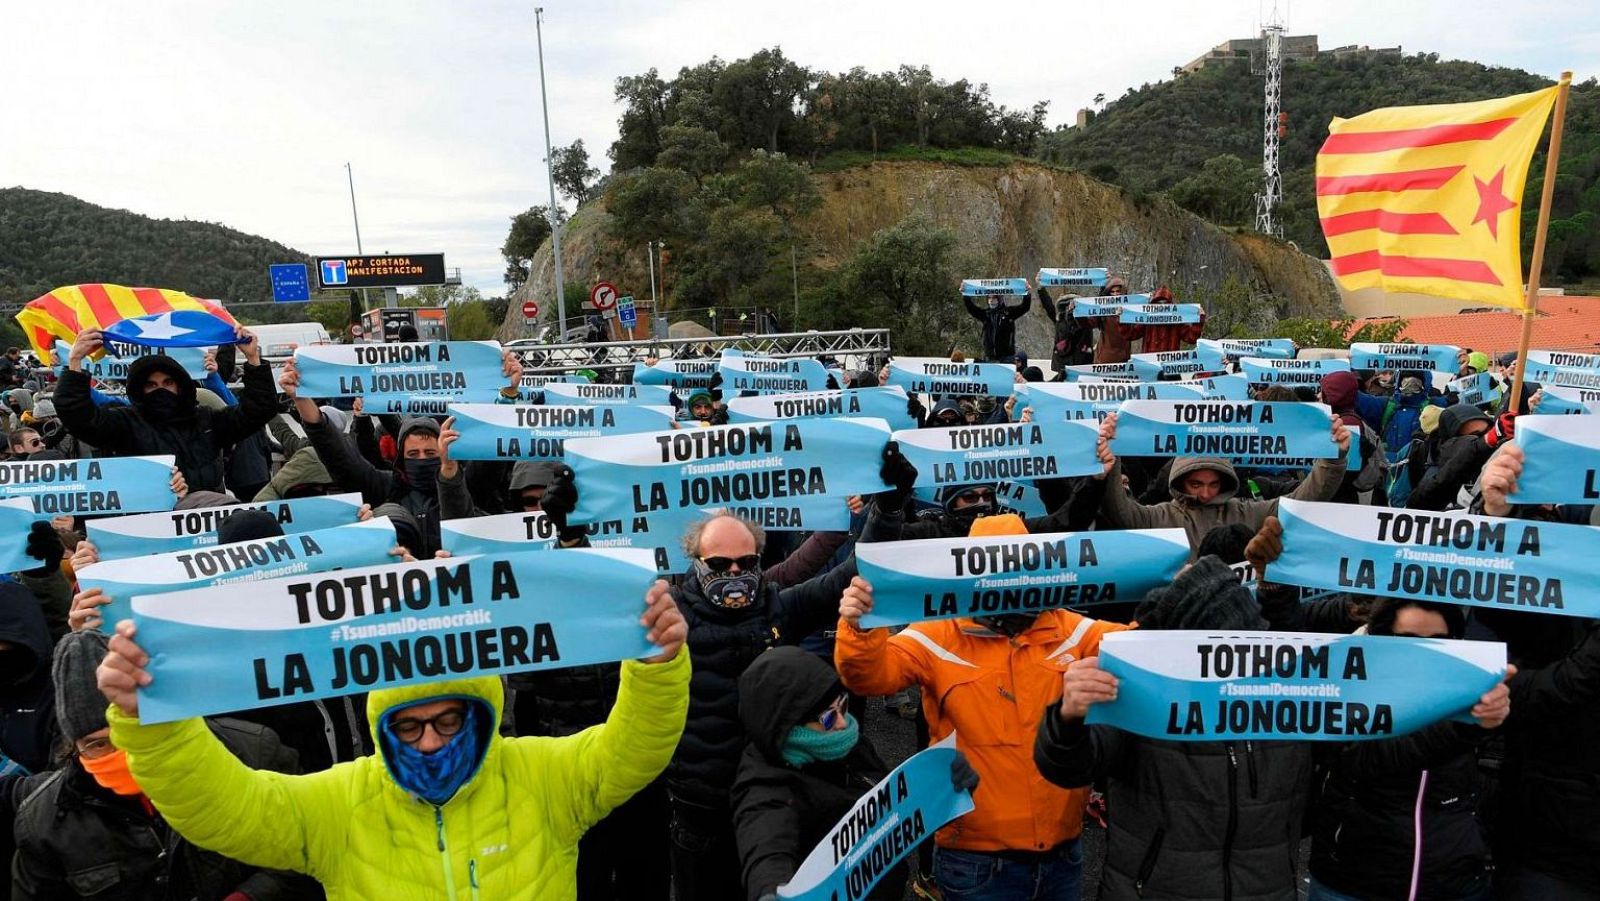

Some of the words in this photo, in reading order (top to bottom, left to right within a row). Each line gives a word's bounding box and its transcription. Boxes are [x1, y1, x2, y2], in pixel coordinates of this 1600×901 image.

[346, 259, 364, 267] AP7
[370, 258, 410, 266] CORTADA
[347, 266, 423, 276] MANIFESTACION
[1142, 305, 1170, 313] TOTHOM
[1145, 315, 1182, 323] JONQUERA
[355, 345, 430, 365] TOTHOM
[438, 344, 450, 362] A
[1156, 353, 1190, 362] TOTHOM
[1192, 351, 1198, 360] A
[1378, 344, 1418, 354] TOTHOM
[1422, 345, 1429, 354] A
[674, 362, 715, 373] TOTHOM
[744, 360, 788, 372] TOTHOM
[792, 362, 800, 372] A
[923, 363, 968, 376] TOTHOM
[972, 364, 980, 376] A
[1092, 365, 1126, 373] TOTHOM
[1128, 364, 1134, 372] A
[1270, 360, 1310, 368] TOTHOM
[1314, 360, 1322, 368] A
[1367, 359, 1380, 369] LA
[1383, 360, 1436, 370] JONQUERA
[1550, 353, 1591, 368] TOTHOM
[339, 376, 364, 394] LA
[370, 372, 467, 393] JONQUERA
[734, 378, 748, 389] LA
[751, 378, 808, 391] JONQUERA
[912, 382, 926, 392] LA
[930, 382, 988, 394] JONQUERA
[1208, 379, 1216, 390] A
[1260, 373, 1272, 382] LA
[1276, 374, 1325, 383] JONQUER
[1534, 370, 1549, 381] LA
[1551, 372, 1600, 387] JONQUER
[576, 385, 624, 399] TOTHOM
[629, 386, 637, 398] A
[1078, 385, 1140, 402] TOTHOM
[1147, 386, 1157, 400] A
[387, 400, 402, 413] LA
[406, 400, 447, 413] JONQU
[774, 396, 842, 418] TOTHOM
[849, 396, 861, 413] A
[1174, 404, 1252, 424] TOTHOM
[1260, 405, 1274, 424] A
[516, 408, 594, 427] TOTHOM
[602, 408, 616, 427] A
[496, 438, 522, 457] LA
[656, 424, 772, 463] TOTHOM
[783, 424, 803, 452] A
[949, 426, 1023, 450] TOTHOM
[1030, 425, 1043, 444] A
[1154, 434, 1178, 454] LA
[1184, 434, 1288, 454] JONQUERA
[0, 462, 78, 485] OTHOM
[86, 461, 102, 480] A
[680, 456, 782, 476] #TsunamiDemocràtic
[934, 463, 958, 484] LA
[964, 456, 1058, 482] JONQUERA
[632, 482, 670, 514] LA
[678, 466, 826, 508] JONQUERA
[1584, 470, 1600, 498] L
[32, 490, 122, 514] NQUERA
[278, 503, 292, 524] A
[731, 506, 802, 528] QUERA
[523, 515, 622, 540] TOOM
[632, 517, 649, 533] A
[1376, 512, 1506, 554] TOTHOM
[1517, 525, 1542, 556] A
[176, 538, 295, 580] TOTHOM
[301, 534, 322, 557] A
[950, 540, 1068, 576] TOTHOM
[1078, 538, 1098, 567] A
[1395, 547, 1515, 571] #TsunamiDemocràtic
[974, 572, 1078, 588] #TsunamiDemocràtic
[1338, 557, 1376, 590] LA
[1387, 563, 1564, 610] JONQUERA
[288, 563, 473, 624] TOTHOM
[490, 560, 520, 600] A
[923, 592, 958, 618] LA
[968, 582, 1116, 613] JONQUERA
[330, 608, 492, 642] #TsunamiDemocràtic
[253, 652, 314, 700] LA
[330, 622, 561, 690] JONQUERA
[1197, 644, 1329, 680] TOTHOM
[1342, 646, 1368, 680] A
[1219, 682, 1341, 698] #TsunamiDemocràtic
[1166, 701, 1204, 736] LA
[1215, 699, 1394, 736] JONQUERA
[831, 782, 892, 866] TOTHOM
[897, 770, 908, 804] A
